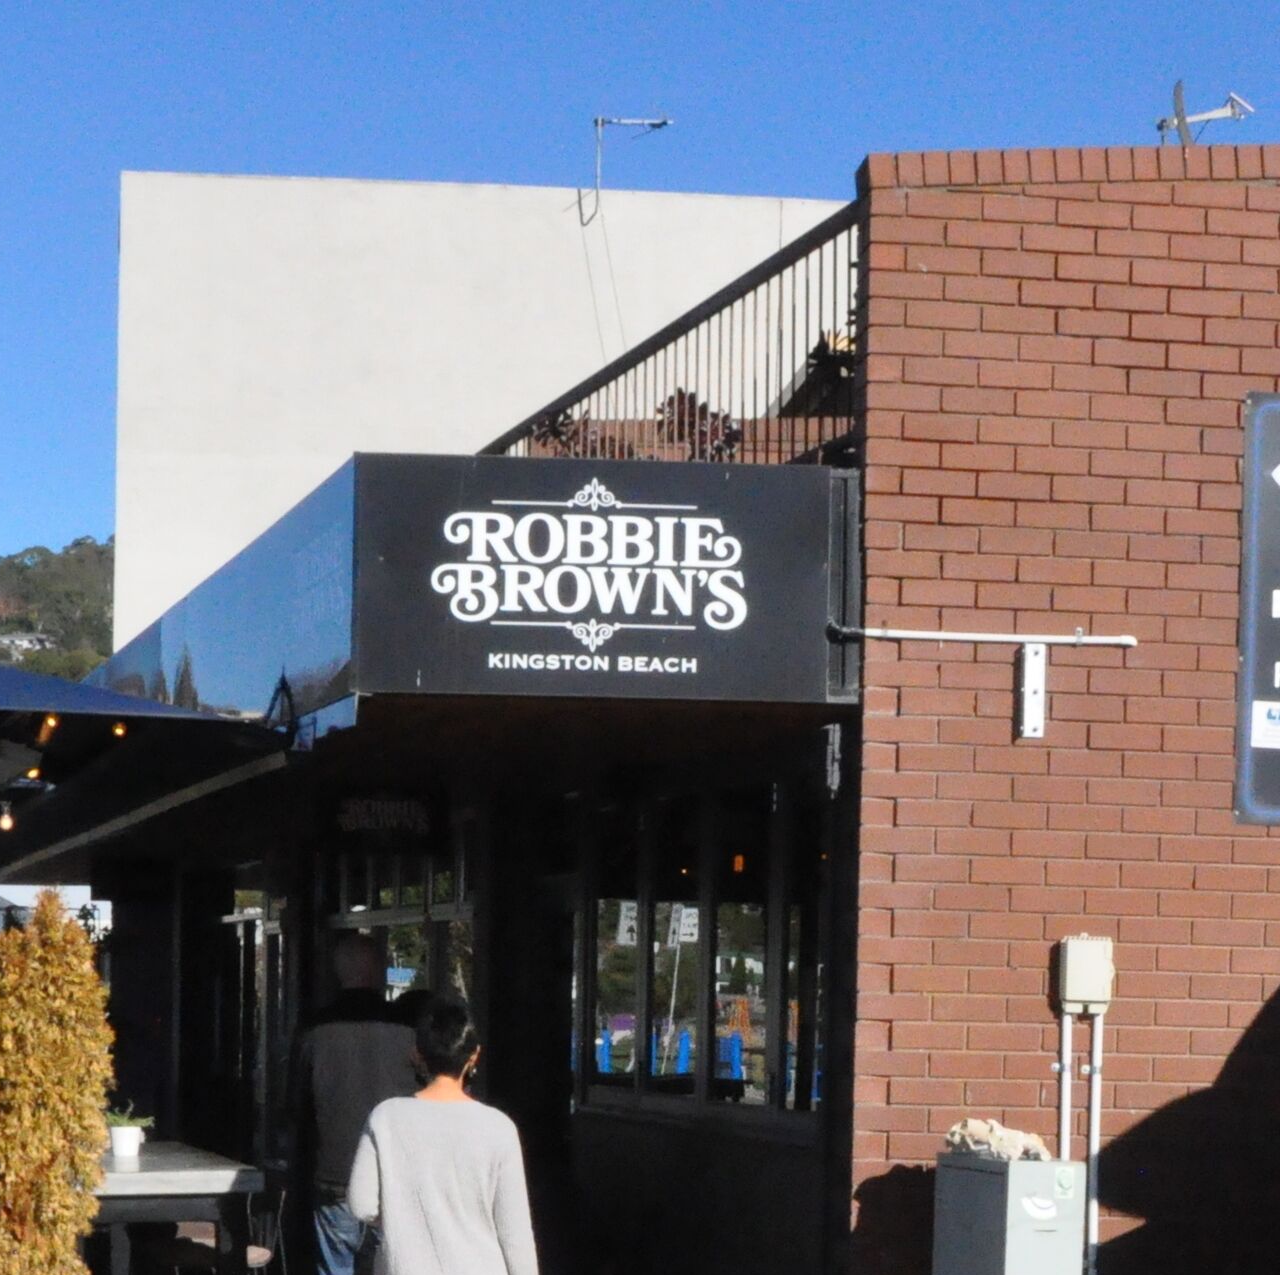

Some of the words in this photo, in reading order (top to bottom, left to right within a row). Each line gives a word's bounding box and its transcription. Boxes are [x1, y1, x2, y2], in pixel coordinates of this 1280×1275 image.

[443, 511, 742, 568] ROBBIE
[430, 563, 748, 630] BROWN'S
[488, 653, 609, 673] KINGSTON
[618, 655, 697, 674] BEACH
